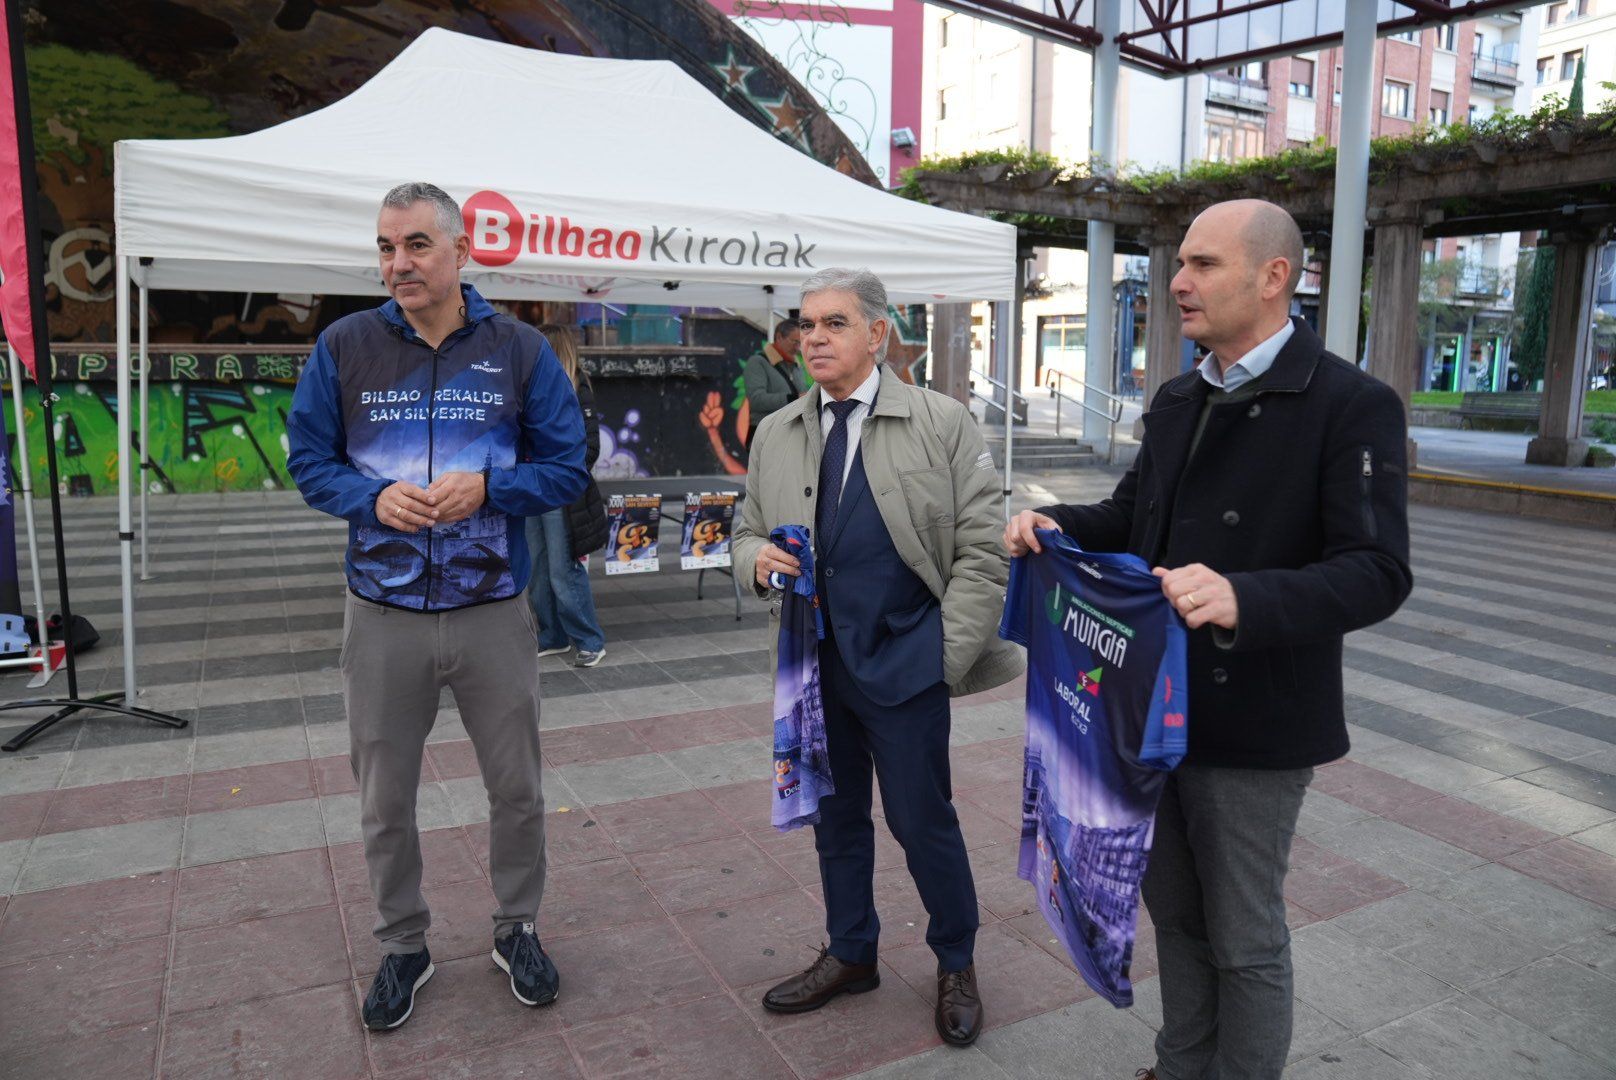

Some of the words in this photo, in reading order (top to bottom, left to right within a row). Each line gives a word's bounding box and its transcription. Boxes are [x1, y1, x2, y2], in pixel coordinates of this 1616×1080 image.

[473, 208, 642, 261] Bilbao
[650, 225, 818, 269] Kirolak
[361, 389, 421, 404] BILBAO
[433, 389, 504, 405] REKALDE
[370, 408, 401, 422] SAN
[404, 407, 486, 421] SILVESTRE
[1063, 606, 1128, 669] MUNGIA
[1054, 677, 1091, 723] LABORAL
